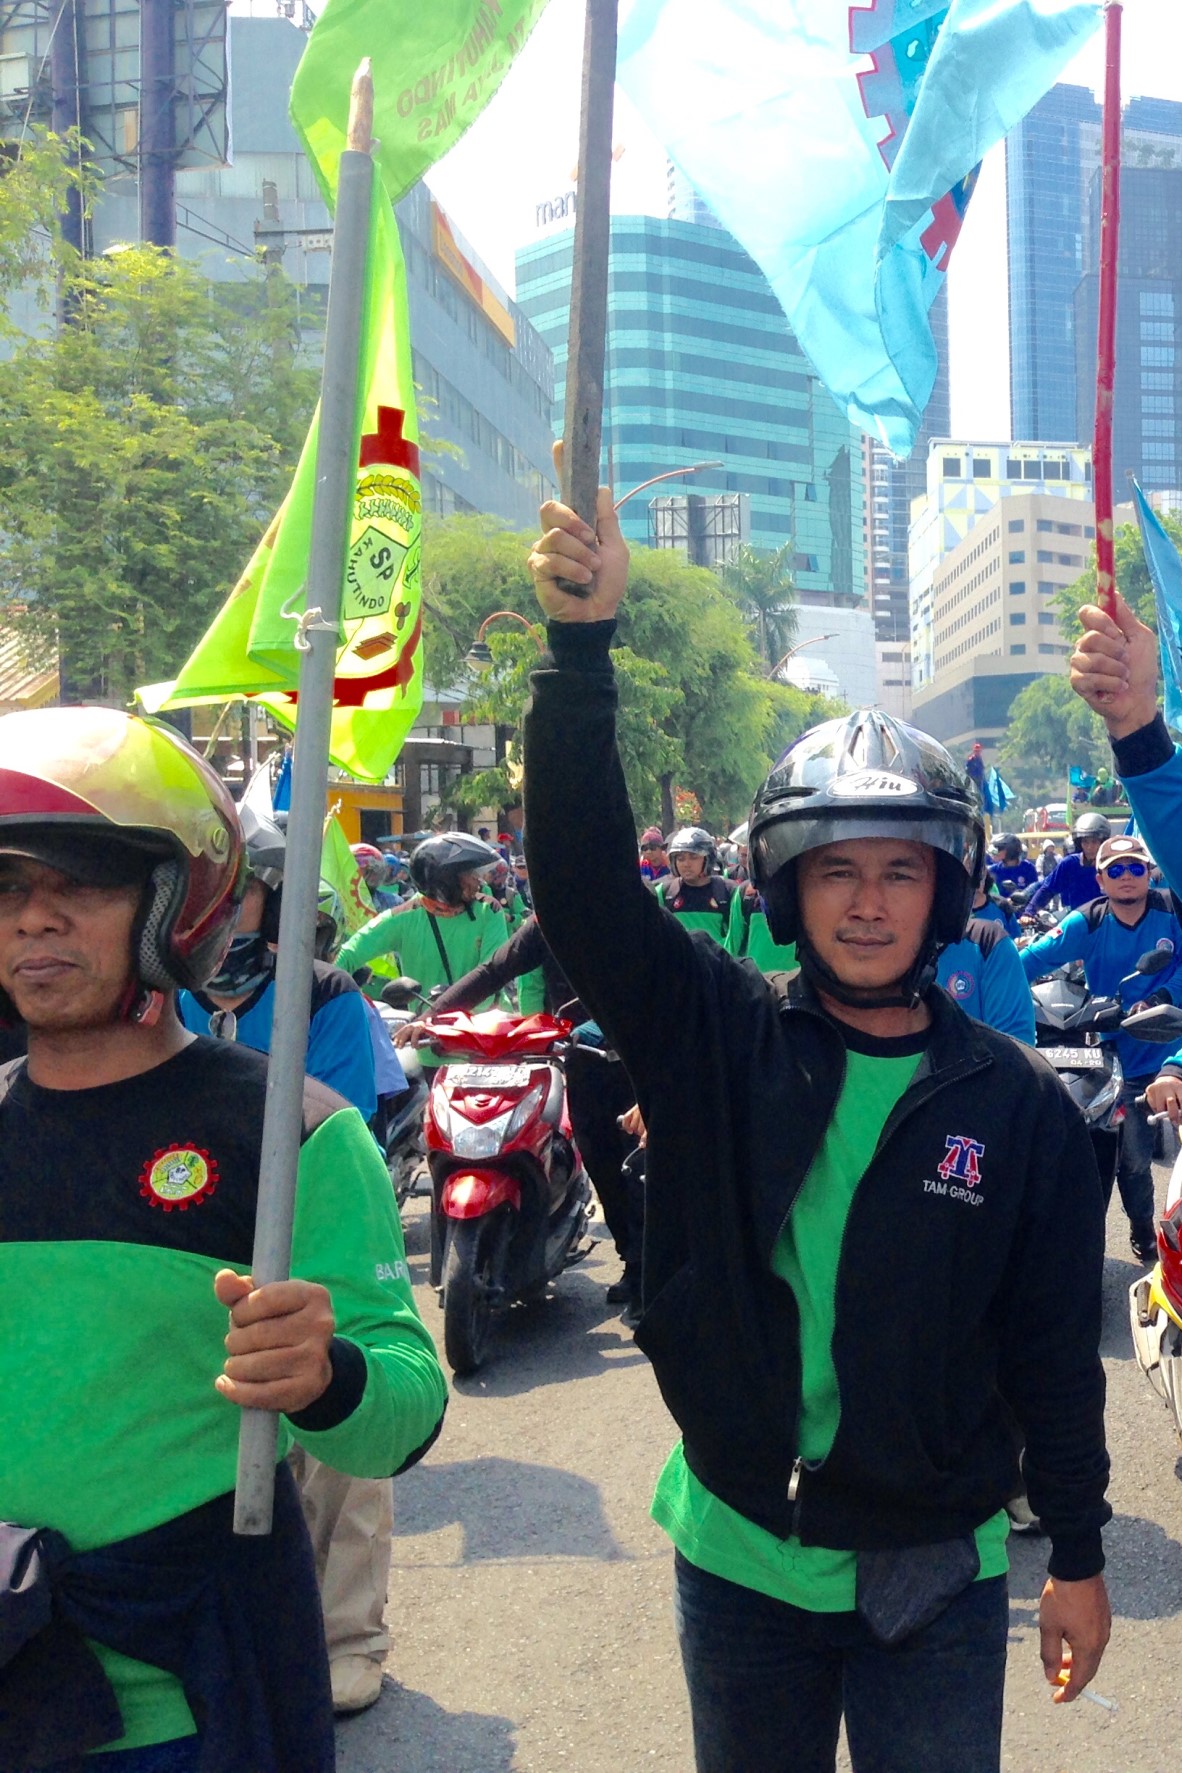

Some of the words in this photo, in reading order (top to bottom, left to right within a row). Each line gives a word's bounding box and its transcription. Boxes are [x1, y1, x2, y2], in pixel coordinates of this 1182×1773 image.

[347, 537, 385, 610] KAHUTINDO
[370, 547, 395, 581] SP
[1045, 1048, 1079, 1059] 6245
[1083, 1049, 1101, 1059] KU
[923, 1180, 948, 1195] TAM
[949, 1185, 985, 1207] GROUP
